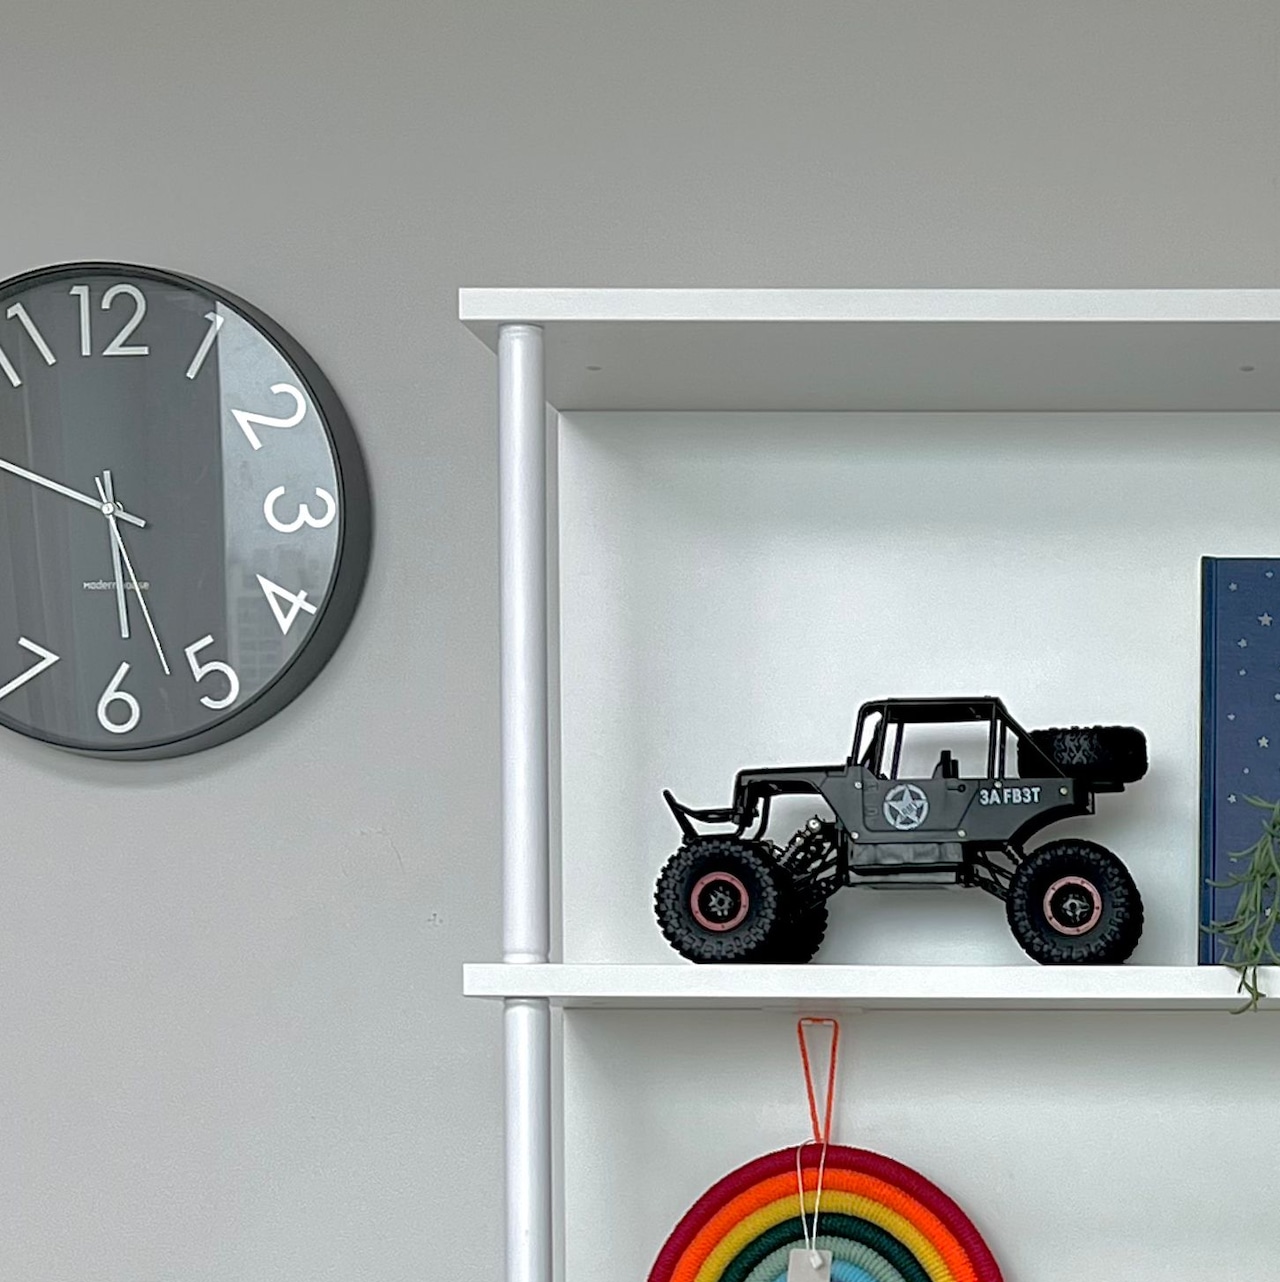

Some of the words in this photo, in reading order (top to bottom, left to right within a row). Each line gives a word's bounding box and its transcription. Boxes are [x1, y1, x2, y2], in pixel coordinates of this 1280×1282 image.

[68, 284, 150, 356] 12
[185, 310, 226, 380] 1
[230, 383, 308, 451] 2
[262, 485, 337, 533] 3
[256, 573, 318, 637] 4
[0, 634, 61, 702] 7
[96, 661, 141, 735] 6
[184, 633, 241, 710] 5
